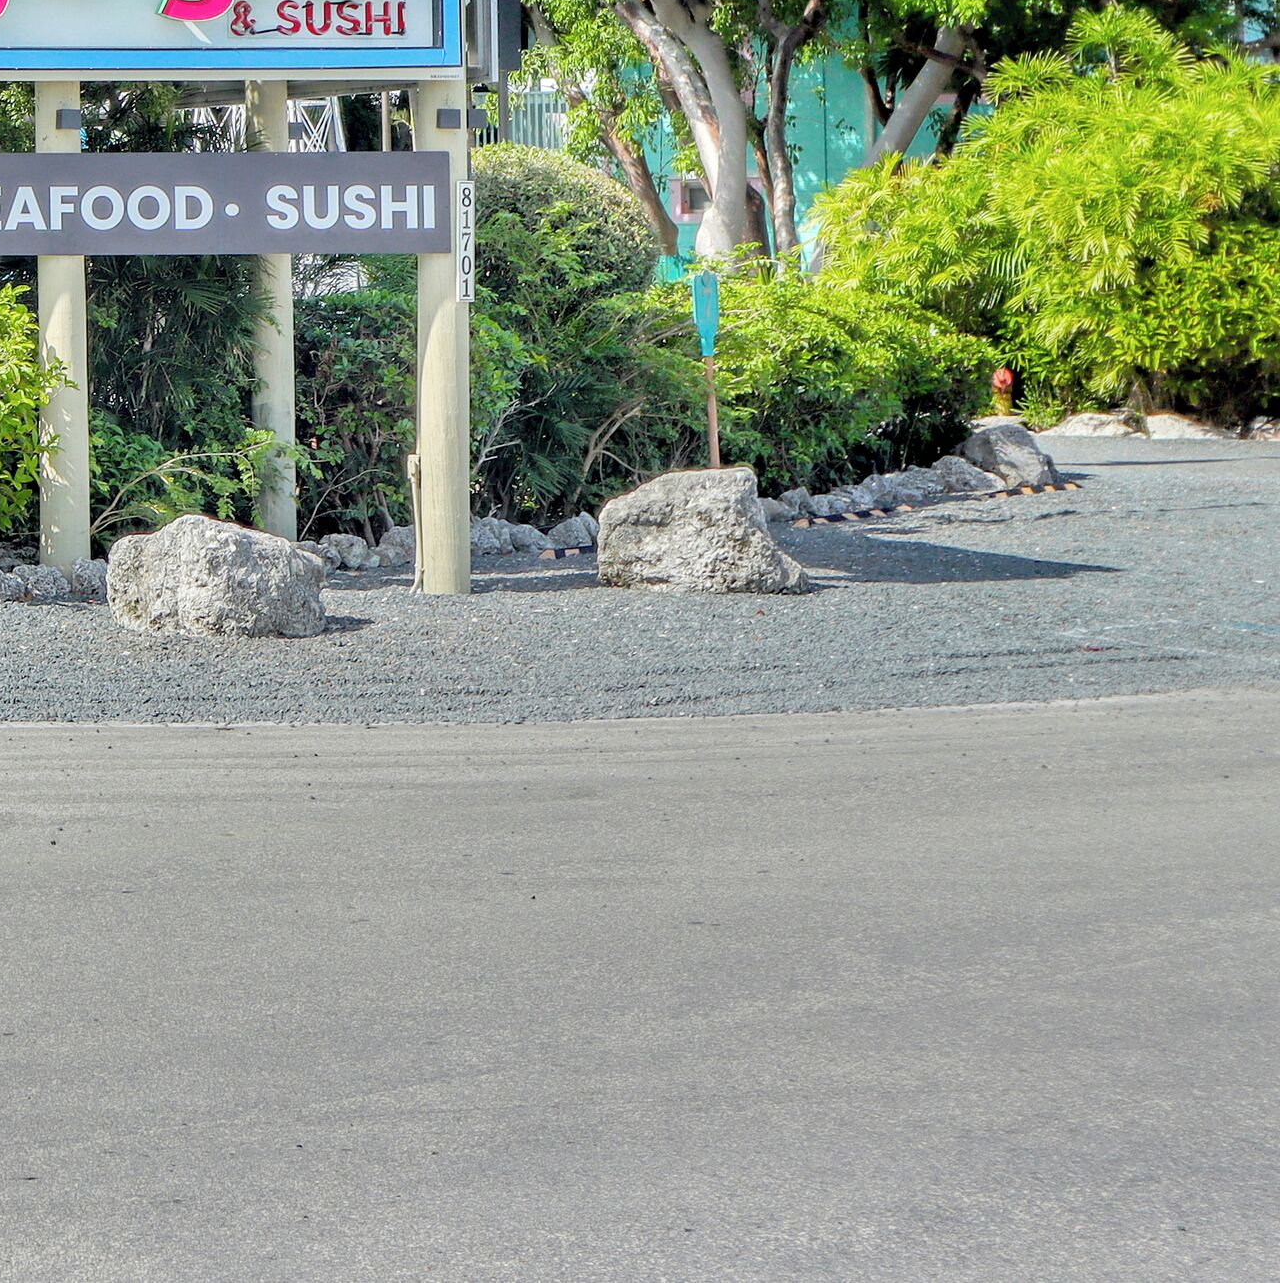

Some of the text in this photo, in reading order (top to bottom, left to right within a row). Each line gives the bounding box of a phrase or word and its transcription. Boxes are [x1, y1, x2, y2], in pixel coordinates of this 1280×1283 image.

[230, 0, 405, 35] & SUSHI
[266, 184, 436, 230] SUSHI
[461, 187, 472, 298] 81701
